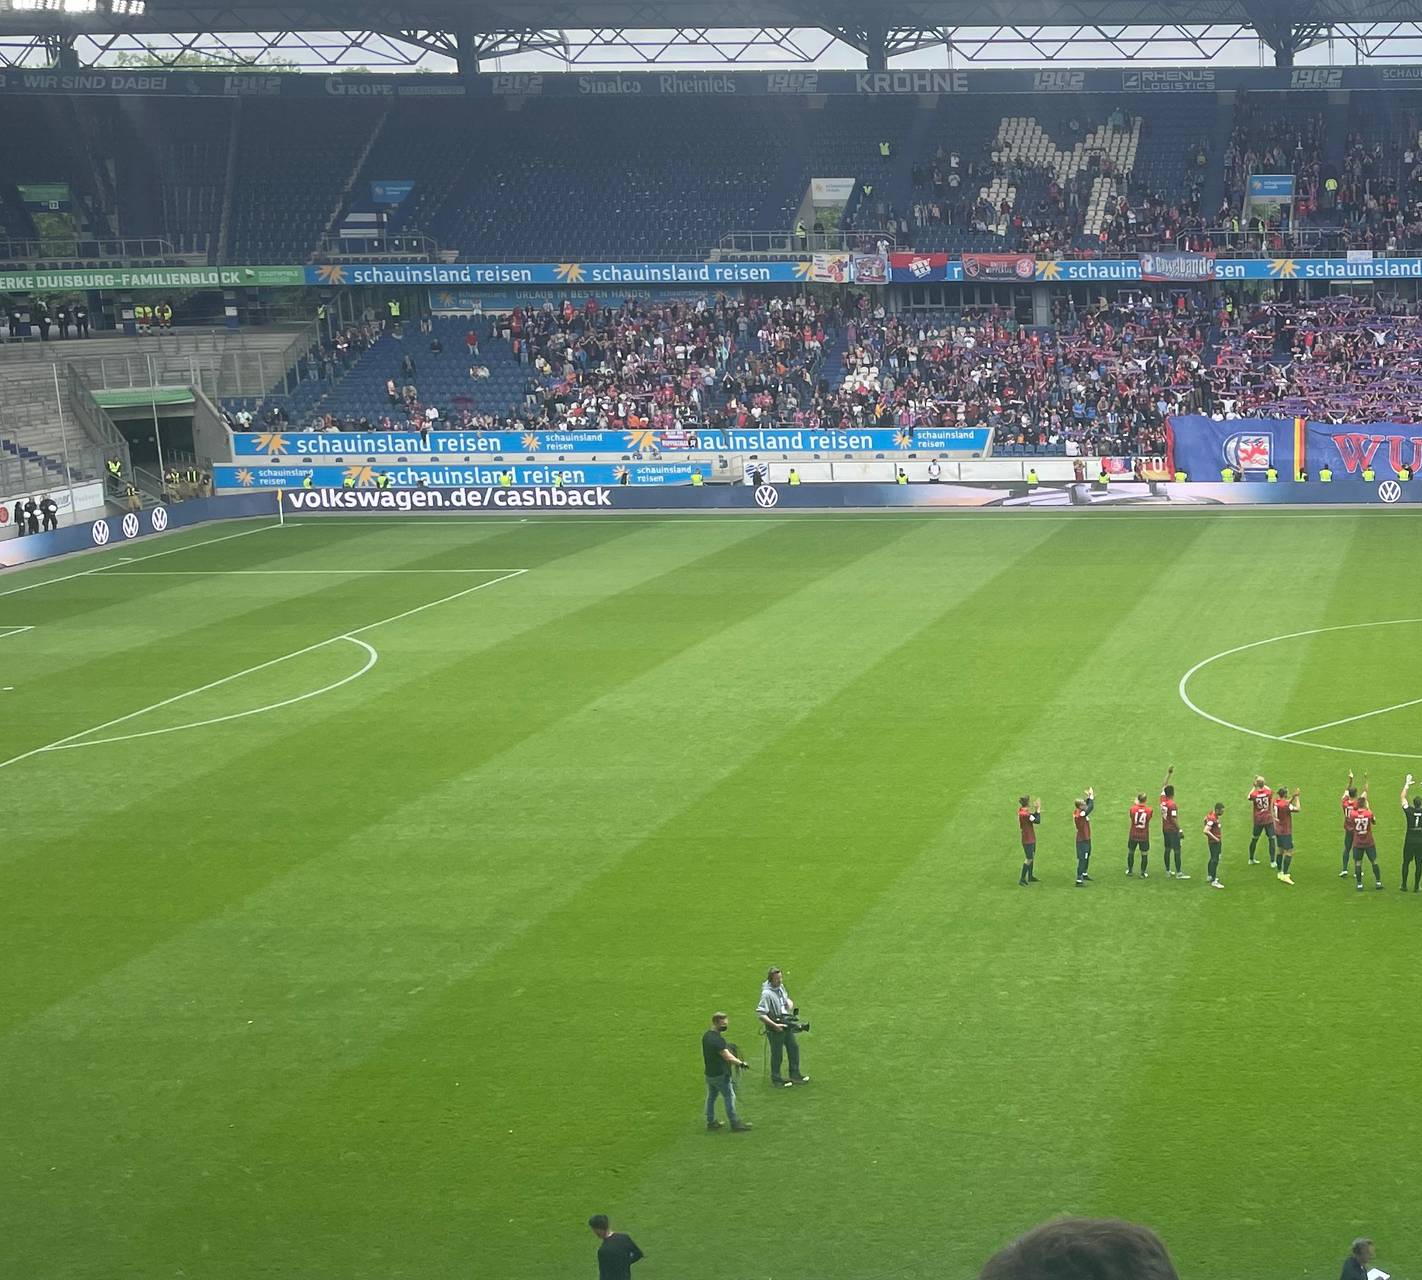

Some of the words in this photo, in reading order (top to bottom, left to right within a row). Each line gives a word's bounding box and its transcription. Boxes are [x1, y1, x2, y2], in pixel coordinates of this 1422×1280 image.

[23, 75, 58, 88] WIR
[62, 76, 105, 89] SIND
[111, 77, 167, 90] DABEI
[855, 72, 969, 92] KROHNE
[1141, 70, 1216, 81] RHENUS
[1290, 69, 1343, 82] 1902
[578, 75, 641, 94] Sinalco
[660, 74, 736, 94] Rheinfels
[1141, 81, 1216, 91] LOGISTICS
[353, 266, 471, 283] schauinsland
[476, 267, 531, 281] reisen
[592, 265, 709, 281] schauinsland
[715, 265, 771, 280] reisen
[1305, 260, 1422, 277] schauinsland
[515, 289, 553, 299] URLAUB
[557, 289, 568, 298] IN
[570, 289, 608, 298] BESTEN
[545, 433, 603, 442] schauinsland
[808, 431, 873, 450] reisen
[917, 430, 975, 440] schauinsland
[297, 434, 431, 453] schauinsland
[437, 434, 501, 452] reisen
[546, 442, 574, 450] reisen
[917, 440, 945, 448] reisen
[258, 468, 314, 478] schauinsland
[523, 466, 585, 484] reisen
[636, 465, 692, 474] schauinsland
[259, 478, 287, 486] reisen
[637, 474, 664, 483] reisen
[289, 487, 611, 510] volkswagen.de/cashback
[1255, 796, 1269, 810] 33
[1134, 811, 1147, 826] 14
